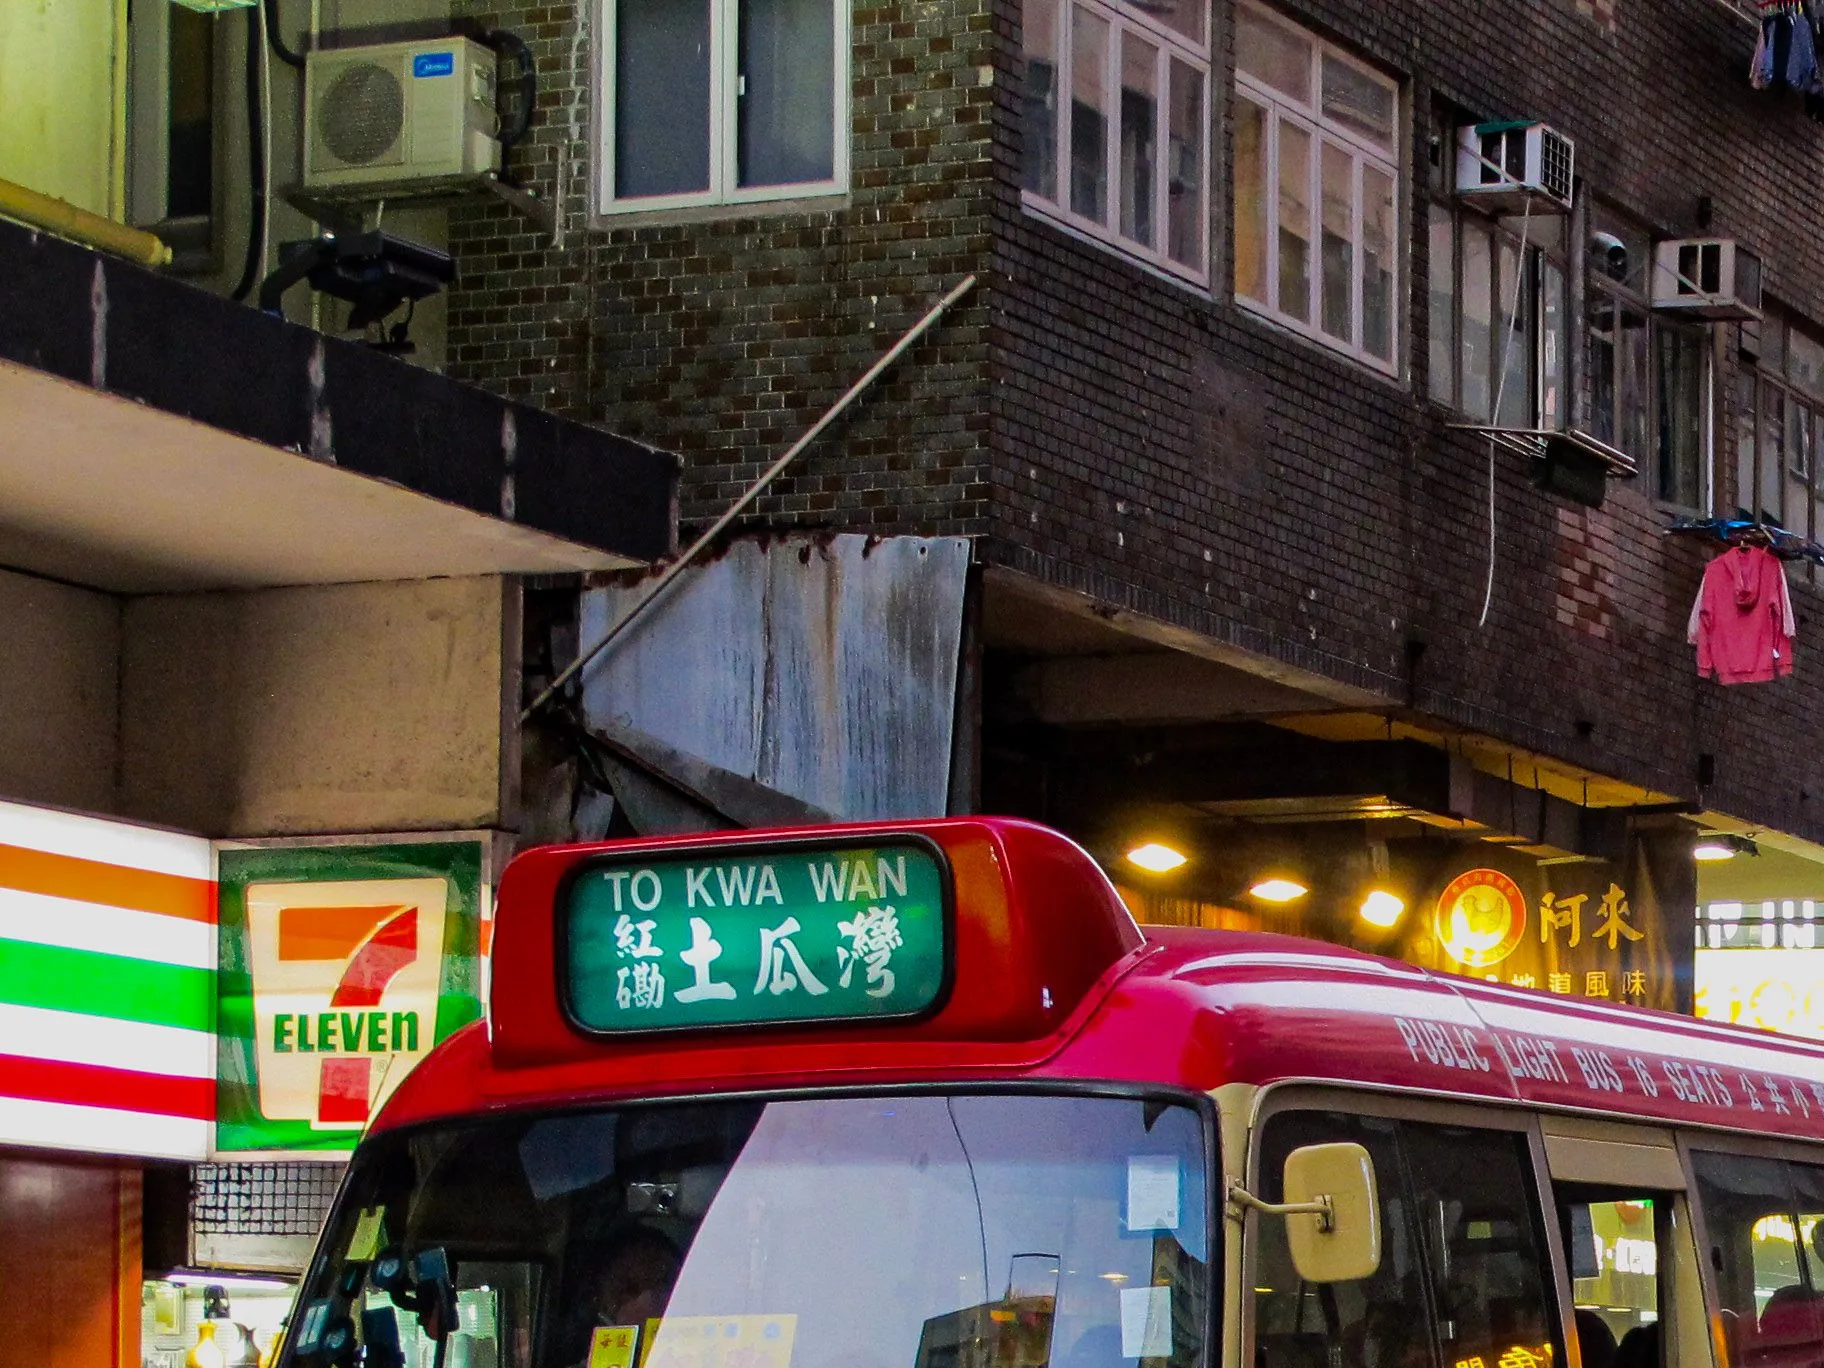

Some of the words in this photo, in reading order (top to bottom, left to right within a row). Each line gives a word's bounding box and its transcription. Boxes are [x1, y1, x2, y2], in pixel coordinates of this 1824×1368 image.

[604, 871, 662, 912] TO
[686, 864, 784, 907] KWA
[808, 856, 906, 902] WAN
[613, 914, 665, 1010] 紅磡
[673, 905, 903, 1003] 土瓜灣
[1394, 1017, 1491, 1072] PUBLIC
[1494, 1033, 1569, 1084] LIGHT
[1572, 1047, 1624, 1093] BUS
[1627, 1055, 1659, 1098] 16
[1663, 1060, 1730, 1108] SEATS
